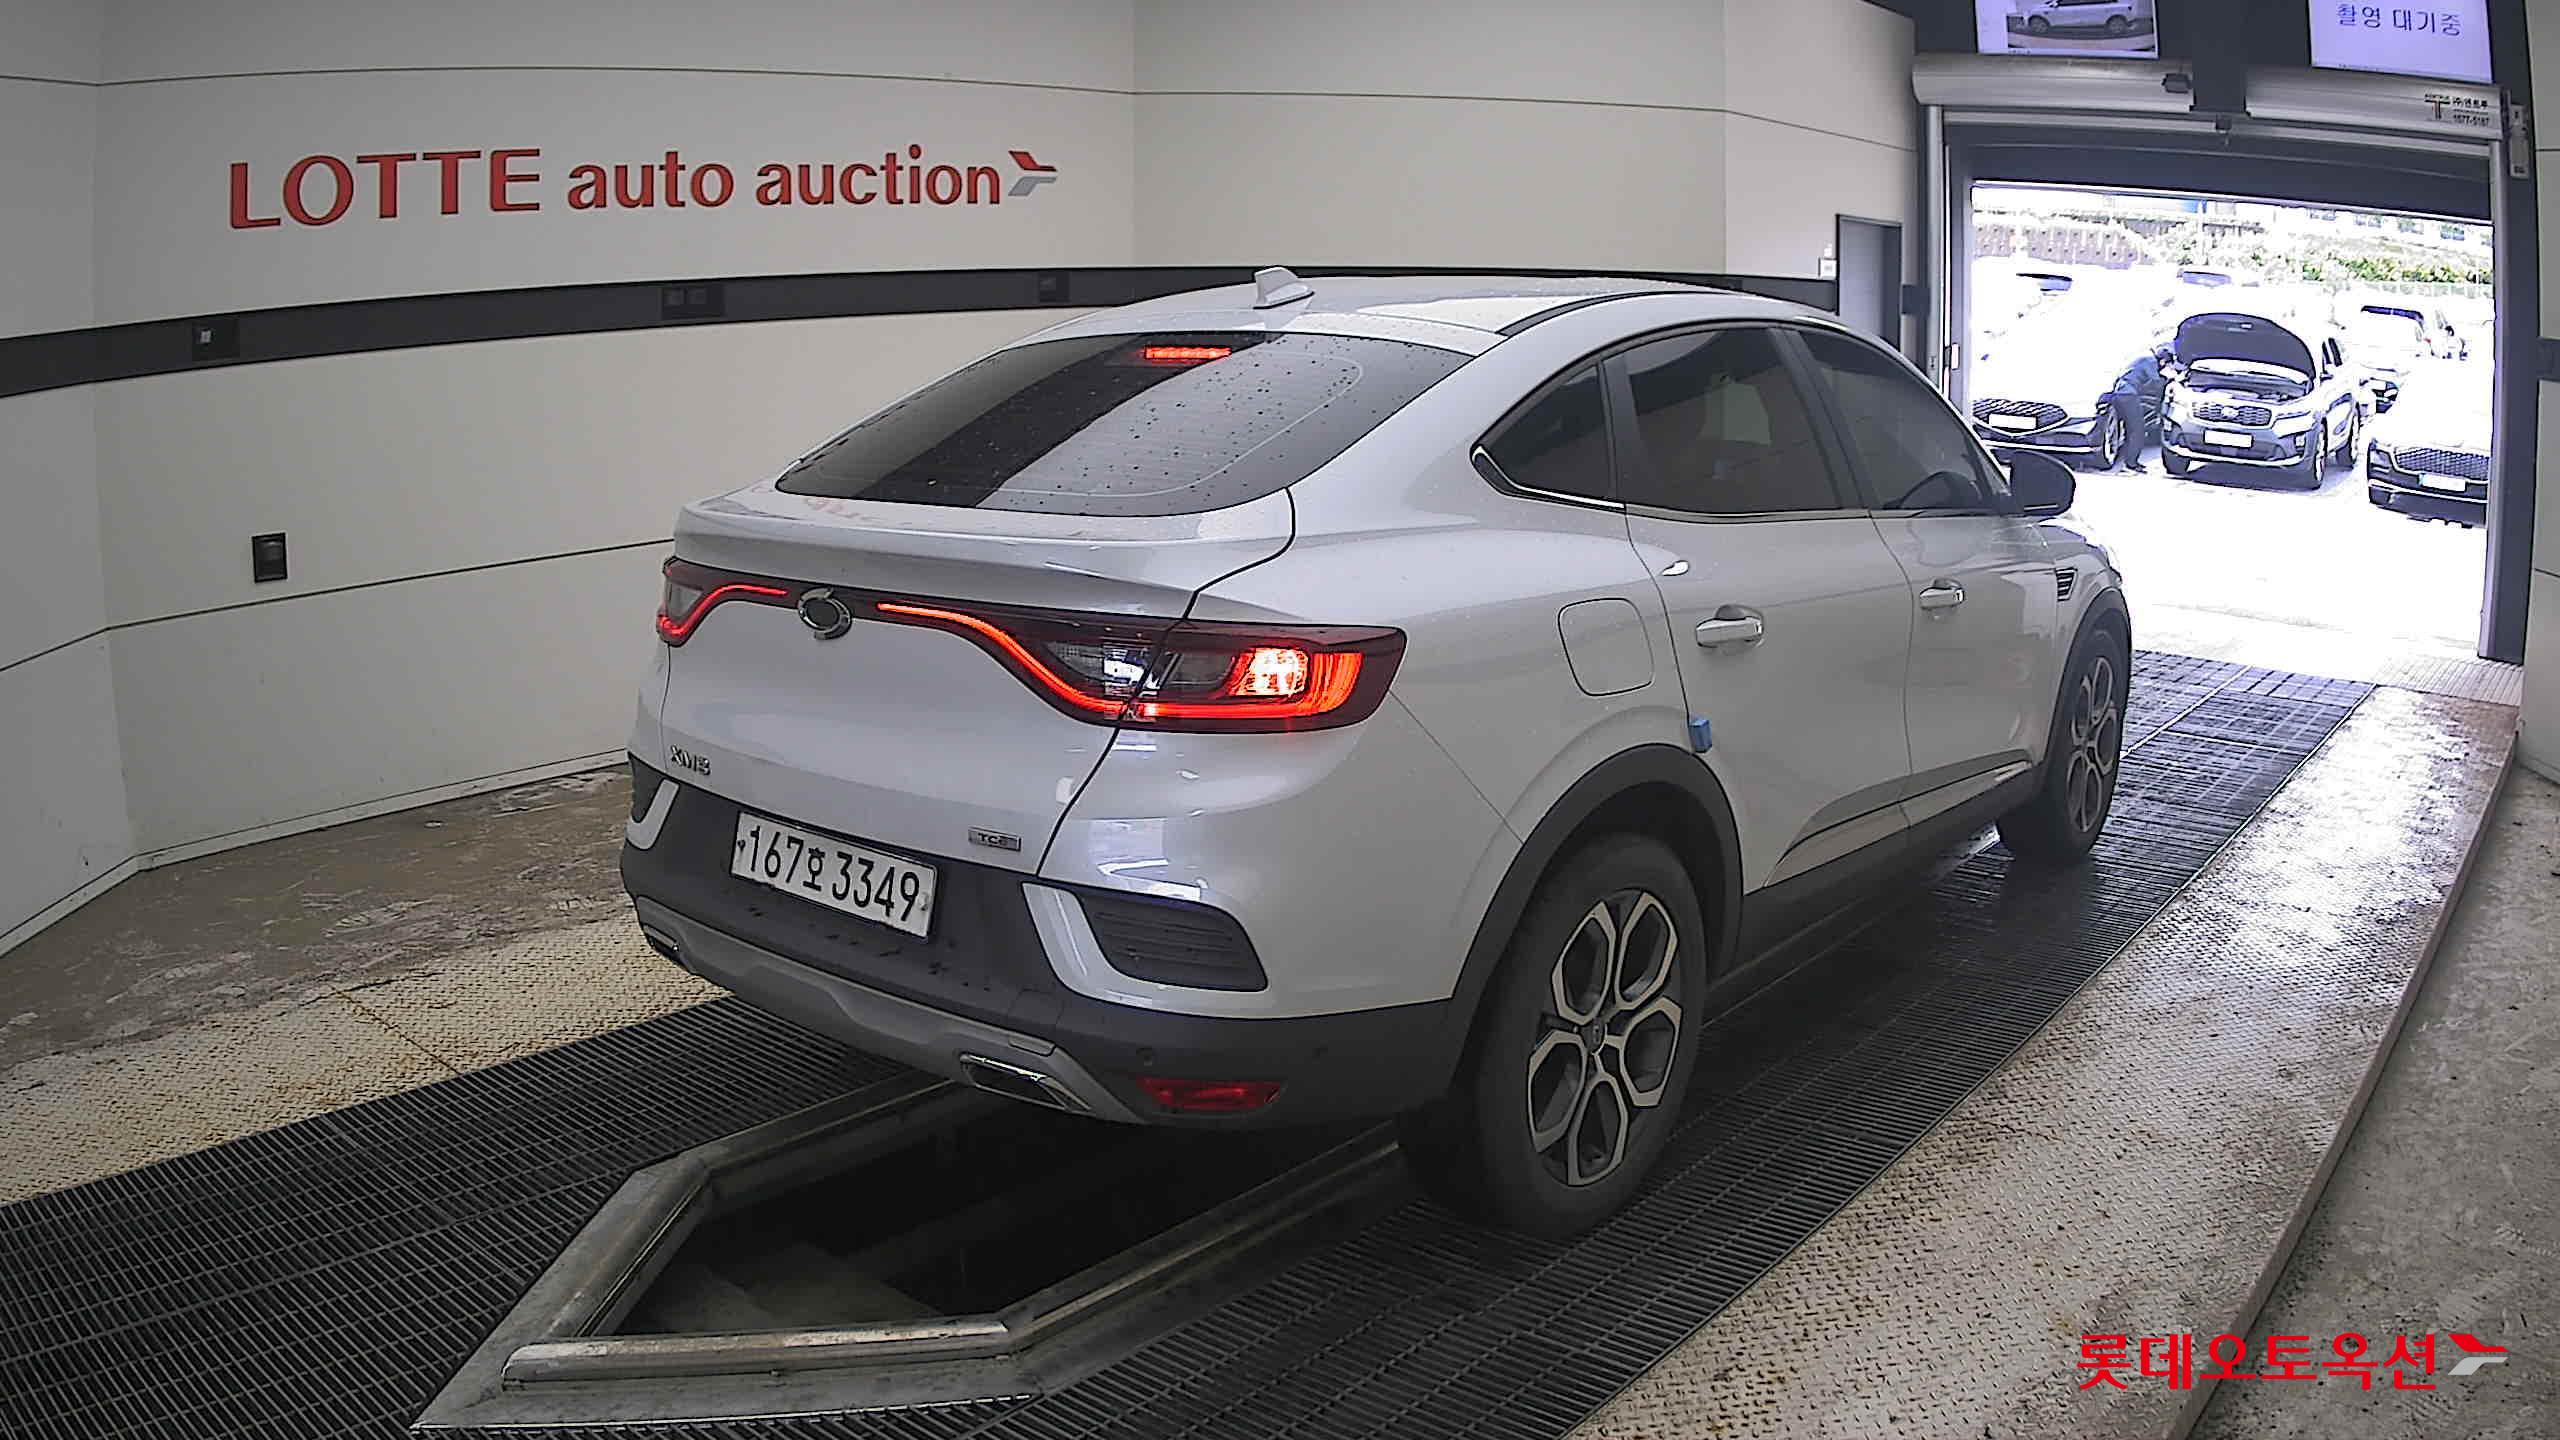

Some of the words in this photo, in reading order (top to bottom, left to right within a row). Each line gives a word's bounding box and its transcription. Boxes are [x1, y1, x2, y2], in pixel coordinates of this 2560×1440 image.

[2337, 3, 2381, 29] 촬영
[2392, 9, 2462, 36] 대기중
[229, 148, 541, 230] LOTTE
[566, 150, 734, 210] auto
[754, 143, 1001, 206] auction
